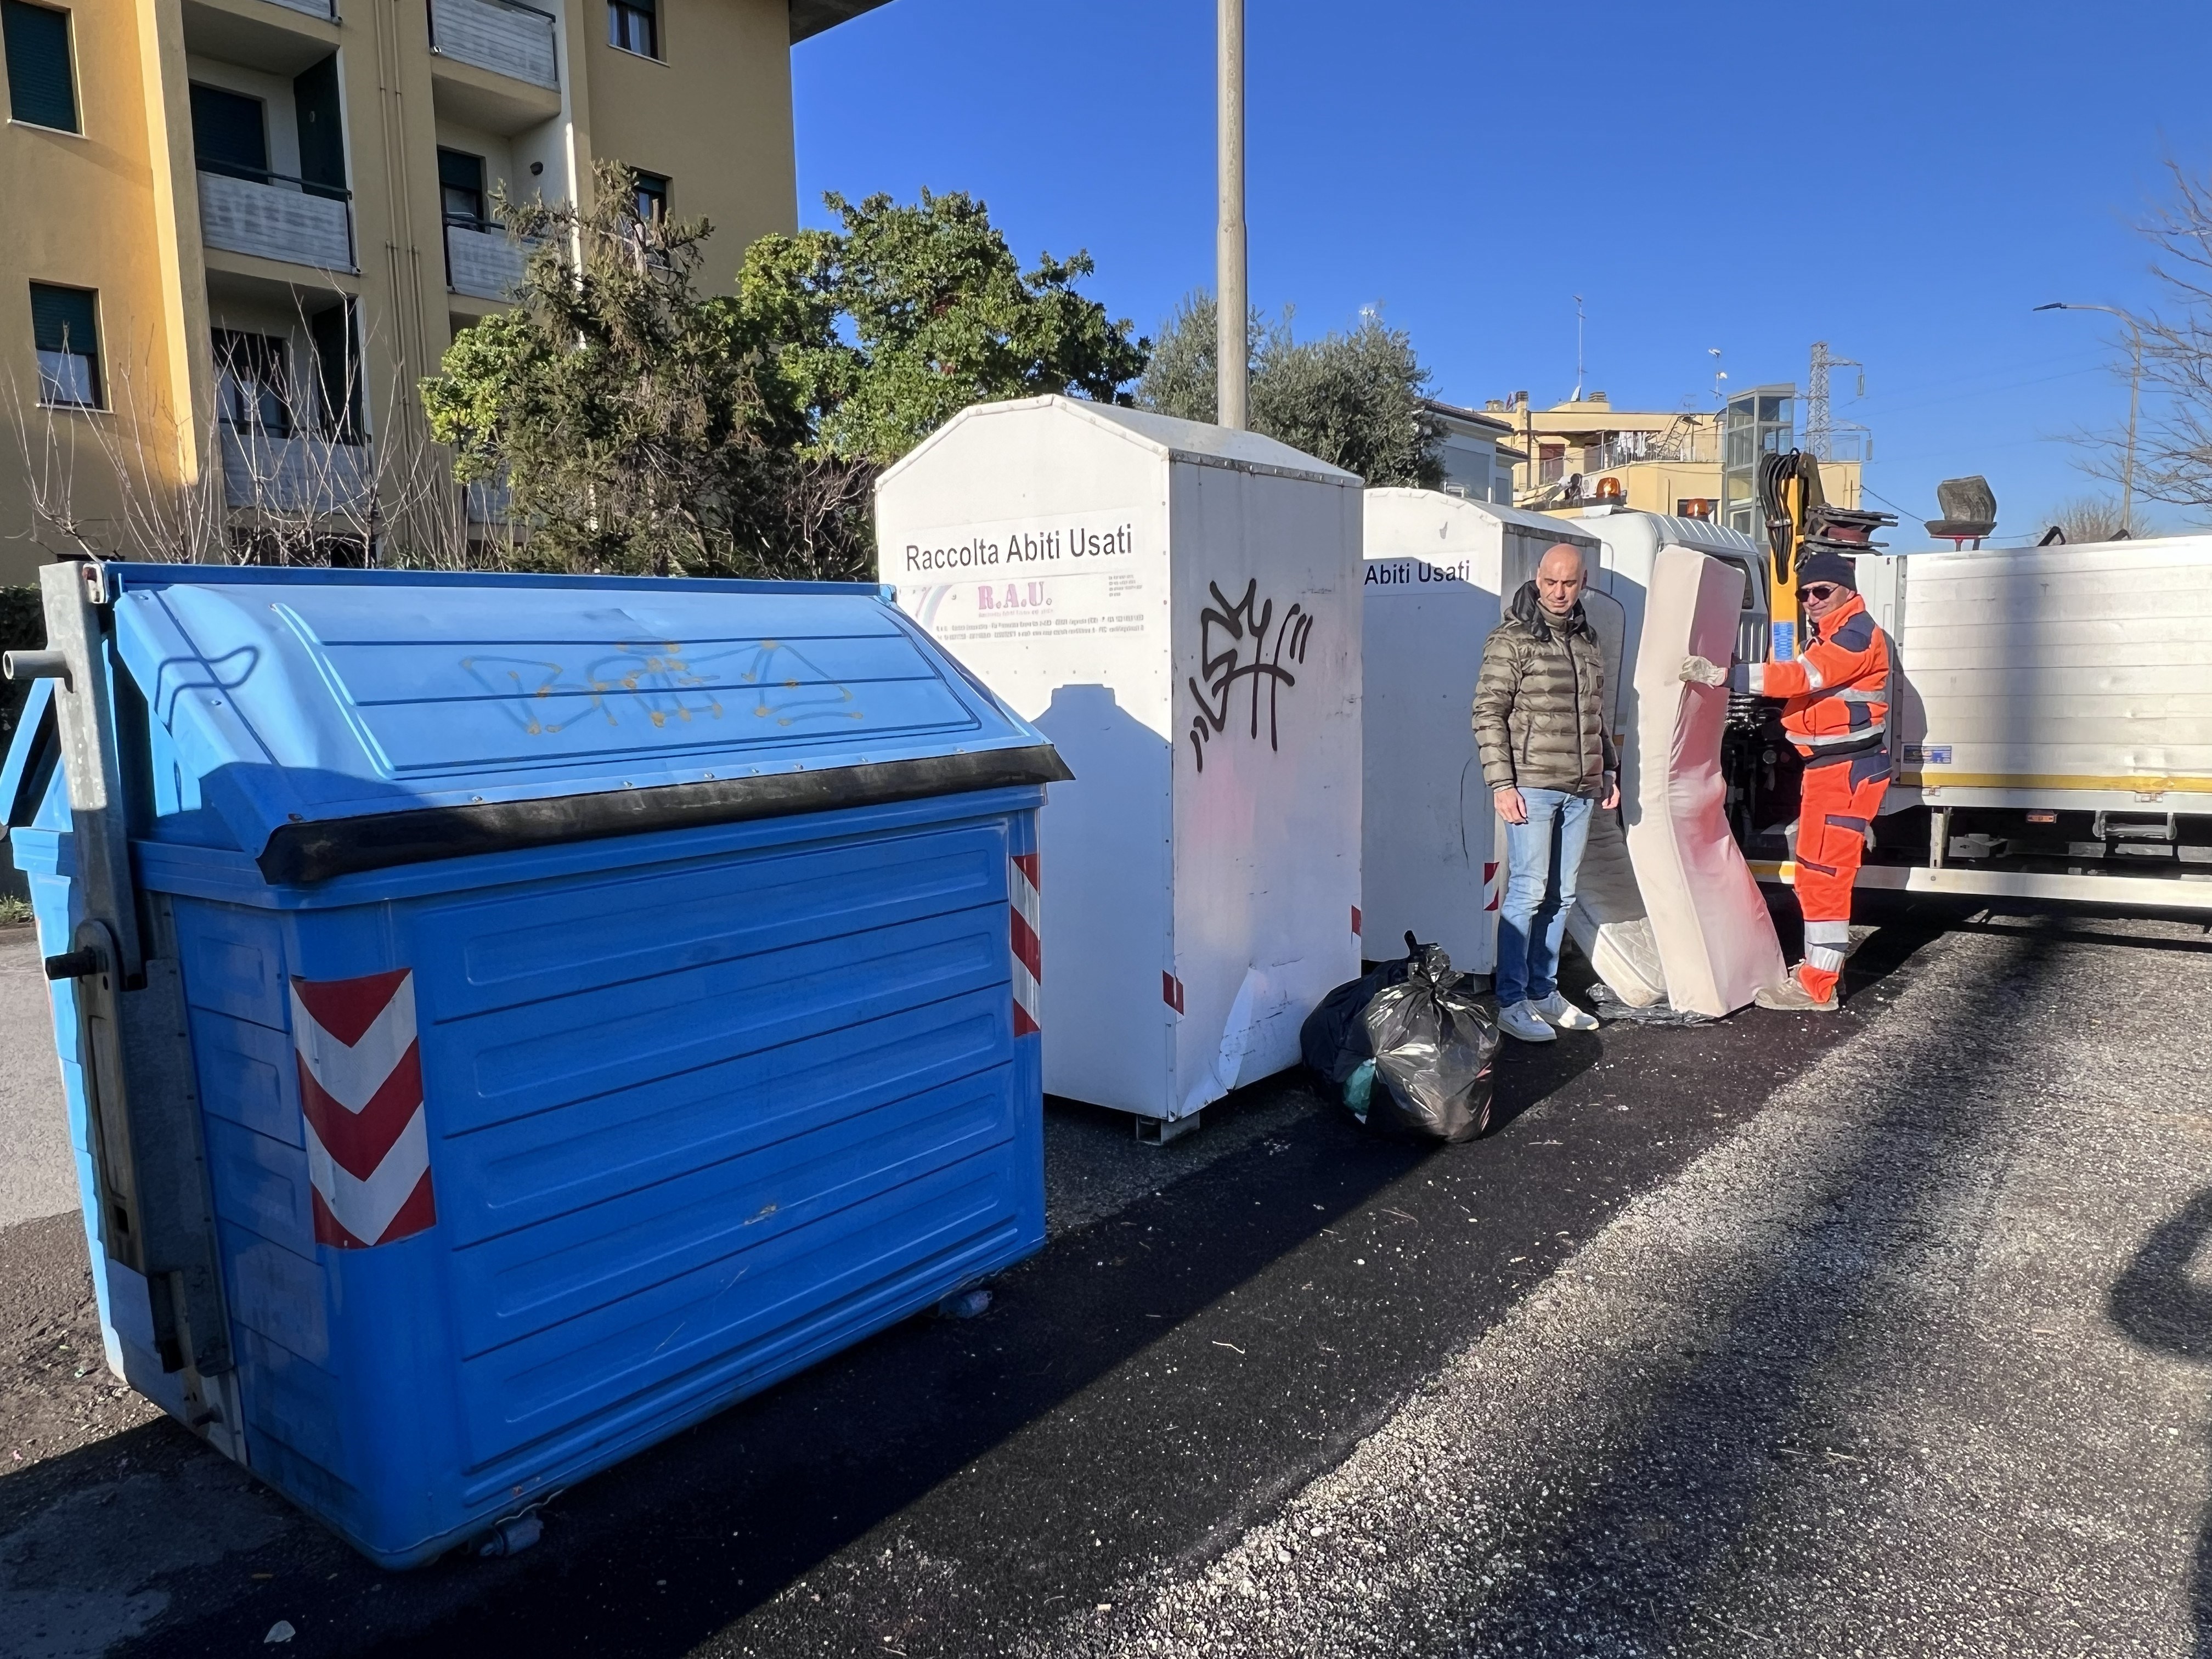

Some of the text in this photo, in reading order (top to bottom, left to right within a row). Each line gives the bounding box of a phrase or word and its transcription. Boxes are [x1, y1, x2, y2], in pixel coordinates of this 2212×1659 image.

[906, 523, 1132, 571] Raccolta Abiti Usati
[1364, 560, 1470, 585] Abiti Usati
[978, 581, 1052, 610] R.A.U.
